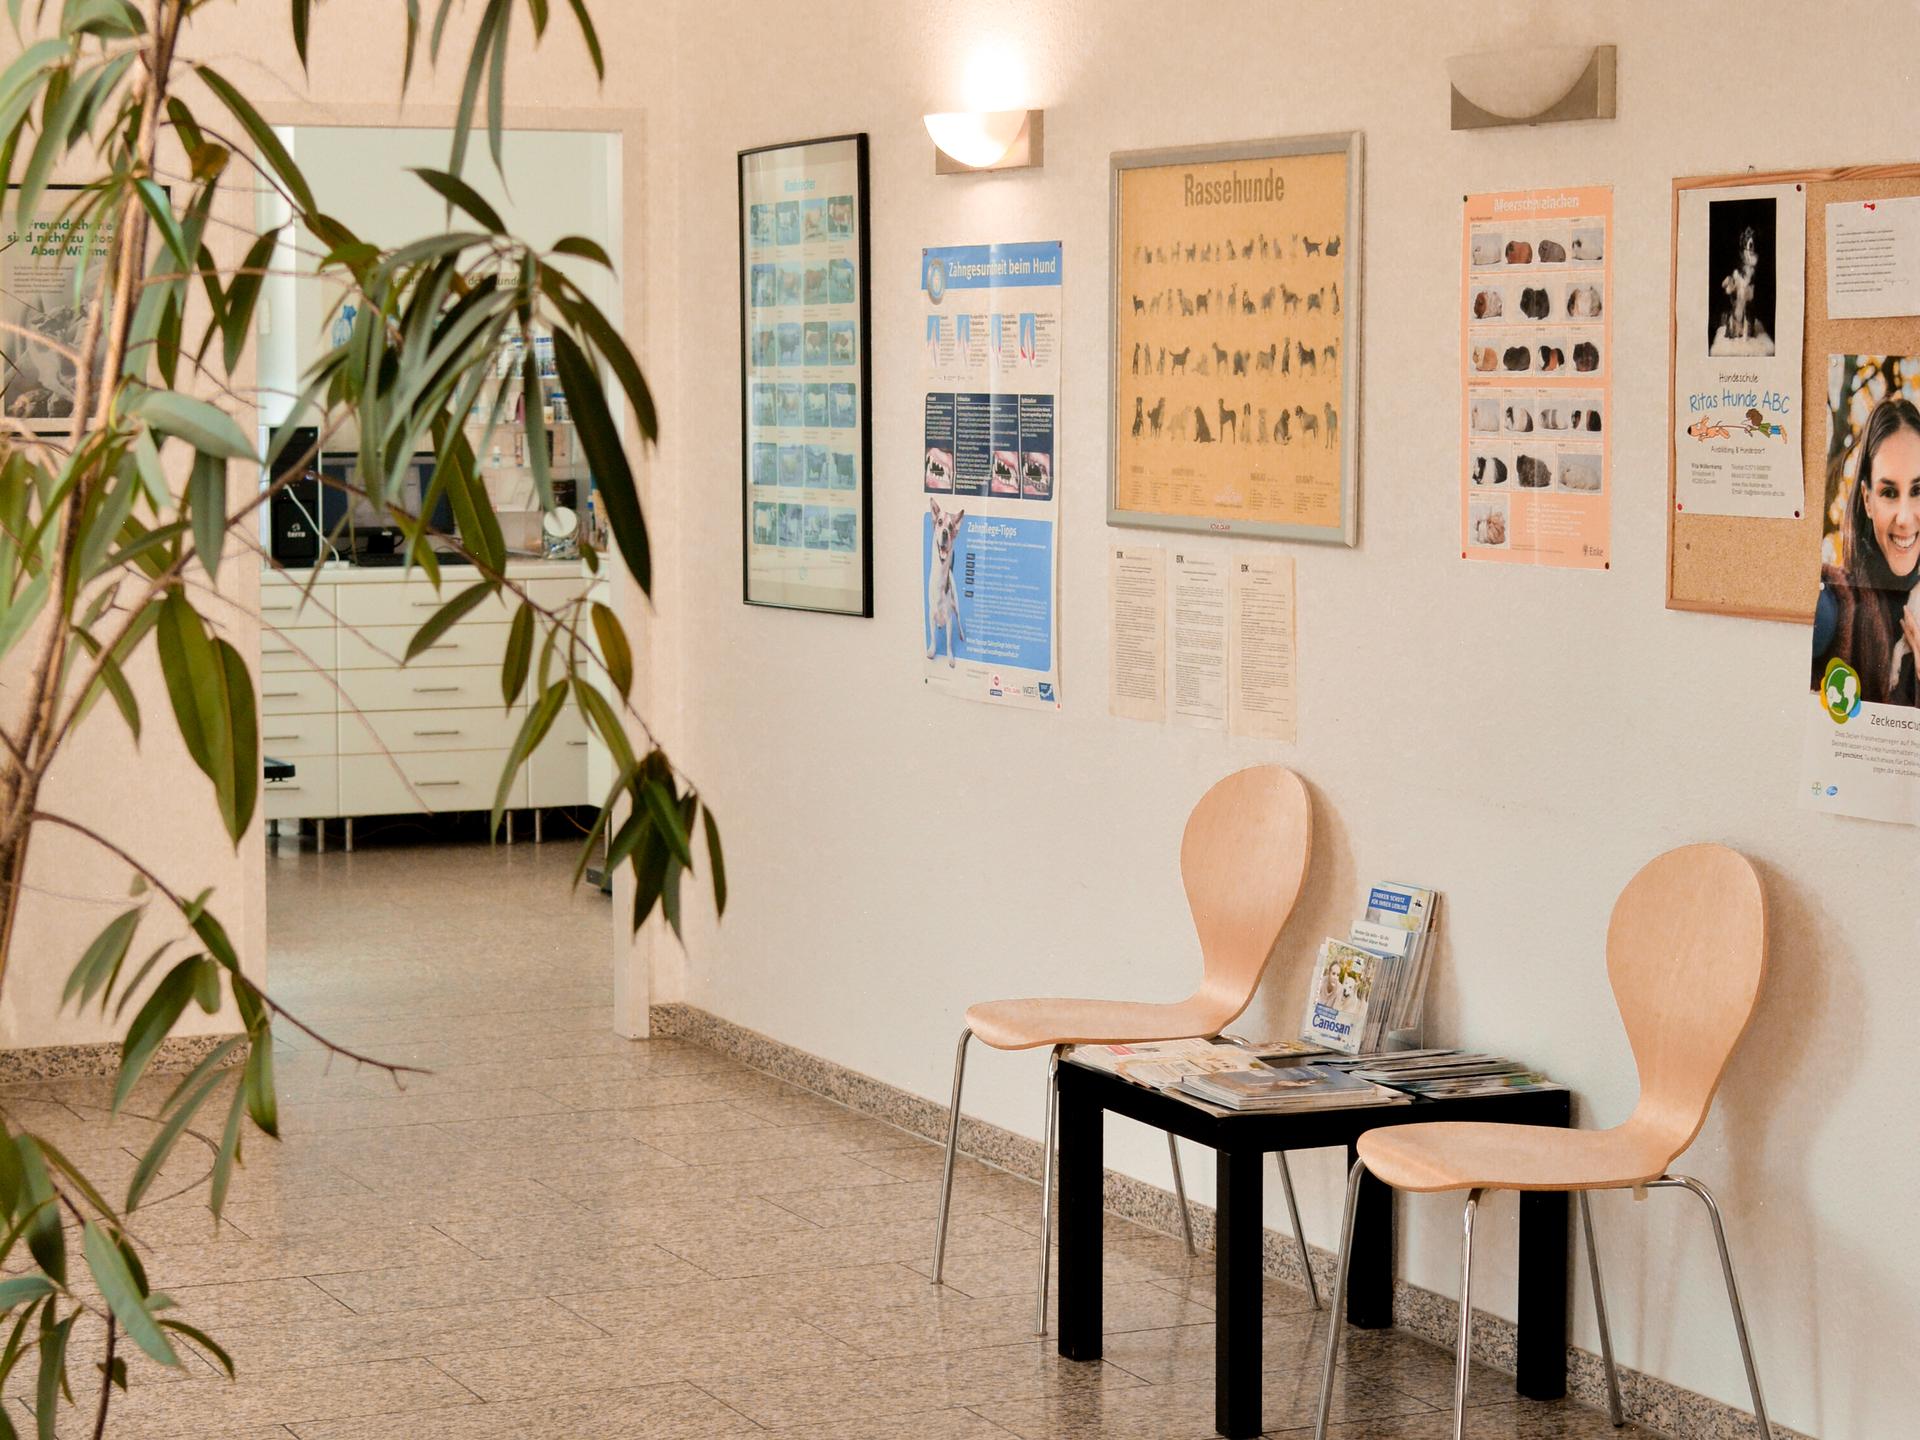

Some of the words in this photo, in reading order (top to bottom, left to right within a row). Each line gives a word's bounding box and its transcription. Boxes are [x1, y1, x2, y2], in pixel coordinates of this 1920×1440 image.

[1184, 167, 1285, 207] Rassehunde
[1008, 257, 1031, 275] beim
[1032, 255, 1056, 274] Hund
[1719, 373, 1759, 383] Hundeschule
[1689, 391, 1718, 413] Ritas
[1722, 387, 1758, 408] Hunde
[1762, 389, 1790, 414] ABC
[1312, 1014, 1351, 1035] Canosan
